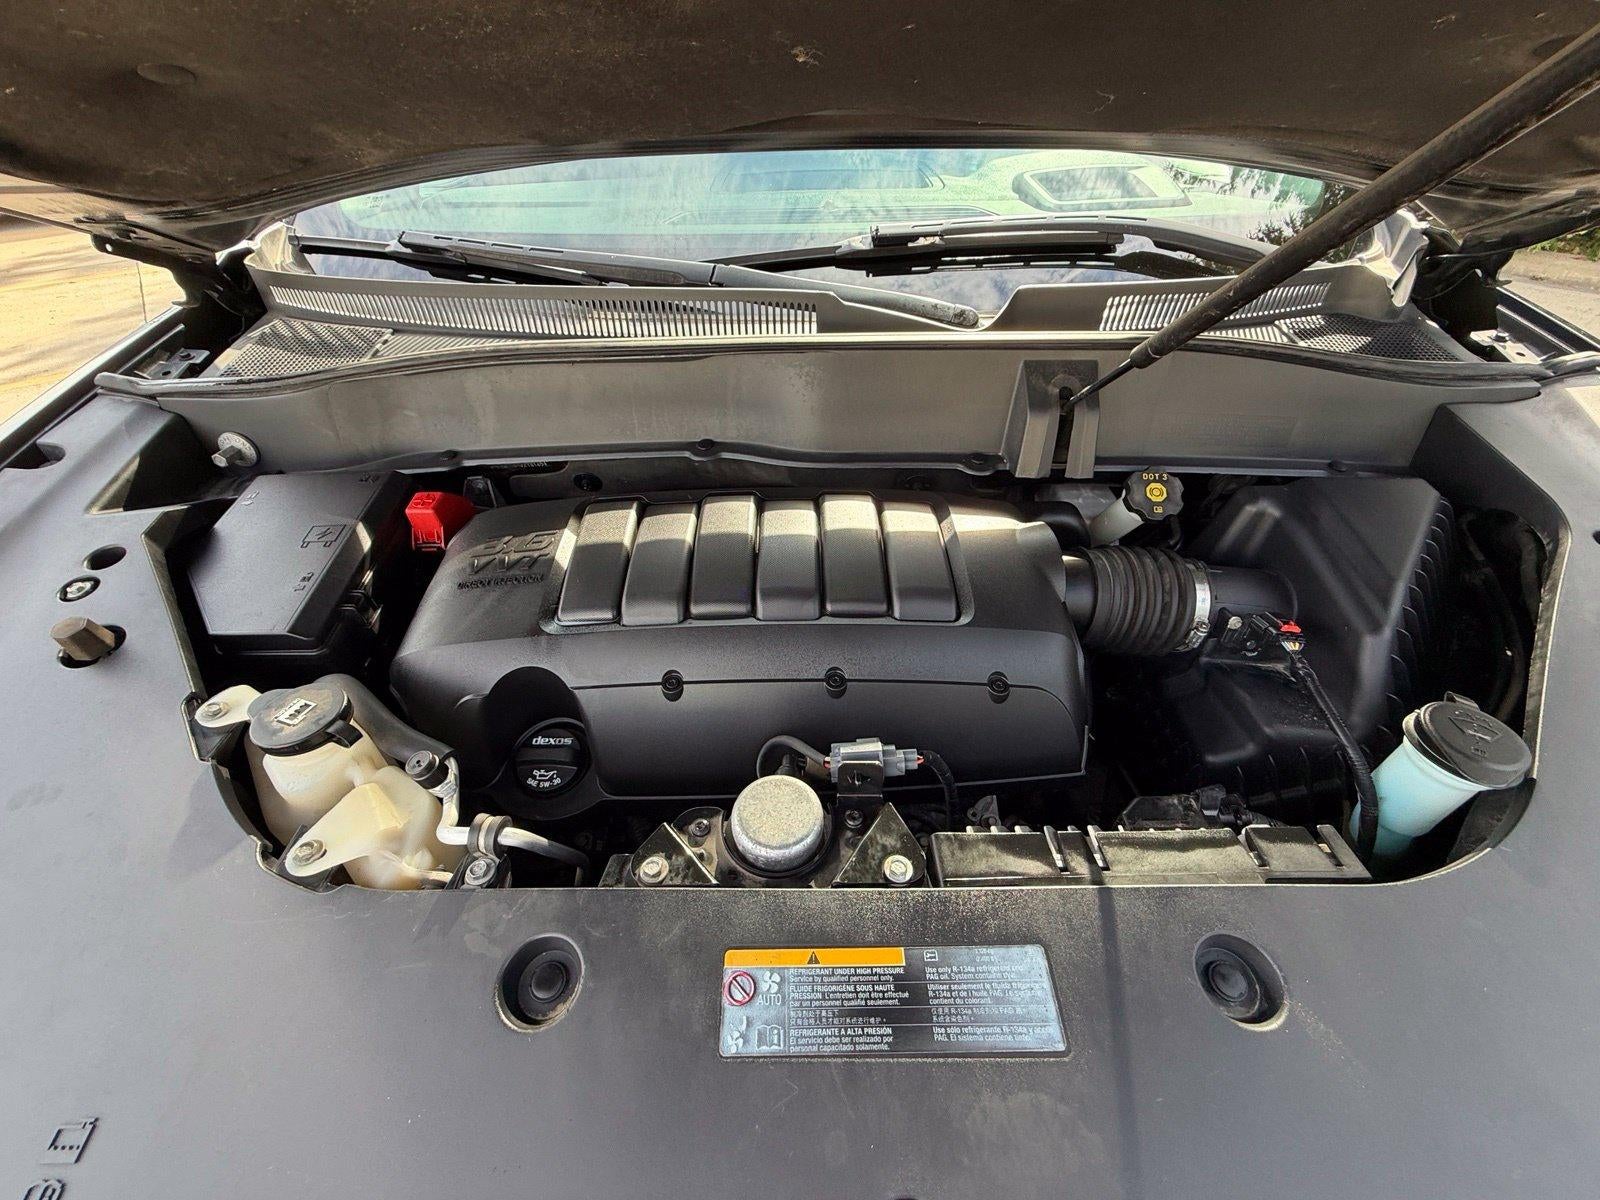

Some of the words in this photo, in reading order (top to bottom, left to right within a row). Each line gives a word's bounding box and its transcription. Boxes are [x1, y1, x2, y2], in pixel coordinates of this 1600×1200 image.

[1162, 473, 1169, 481] 3
[532, 736, 573, 745] dexos
[526, 778, 538, 787] SAE
[539, 778, 561, 788] 5W-30
[790, 968, 834, 976] REFRIGERANT
[938, 966, 951, 974] only
[953, 965, 975, 973] R-134a
[823, 975, 848, 983] qualified
[951, 973, 974, 981] System
[757, 994, 782, 1006] AUTO
[811, 999, 841, 1007] personnel
[790, 1028, 839, 1036] REFRIGERANTE
[864, 1026, 892, 1035] PRESIÓN
[933, 1026, 945, 1034] Use
[962, 1026, 1000, 1035] refrigerante
[798, 1036, 822, 1044] servicio
[824, 1036, 841, 1044] debe
[790, 1045, 818, 1053] personal
[820, 1044, 854, 1052] capacitado
[856, 1043, 890, 1051] solamente.
